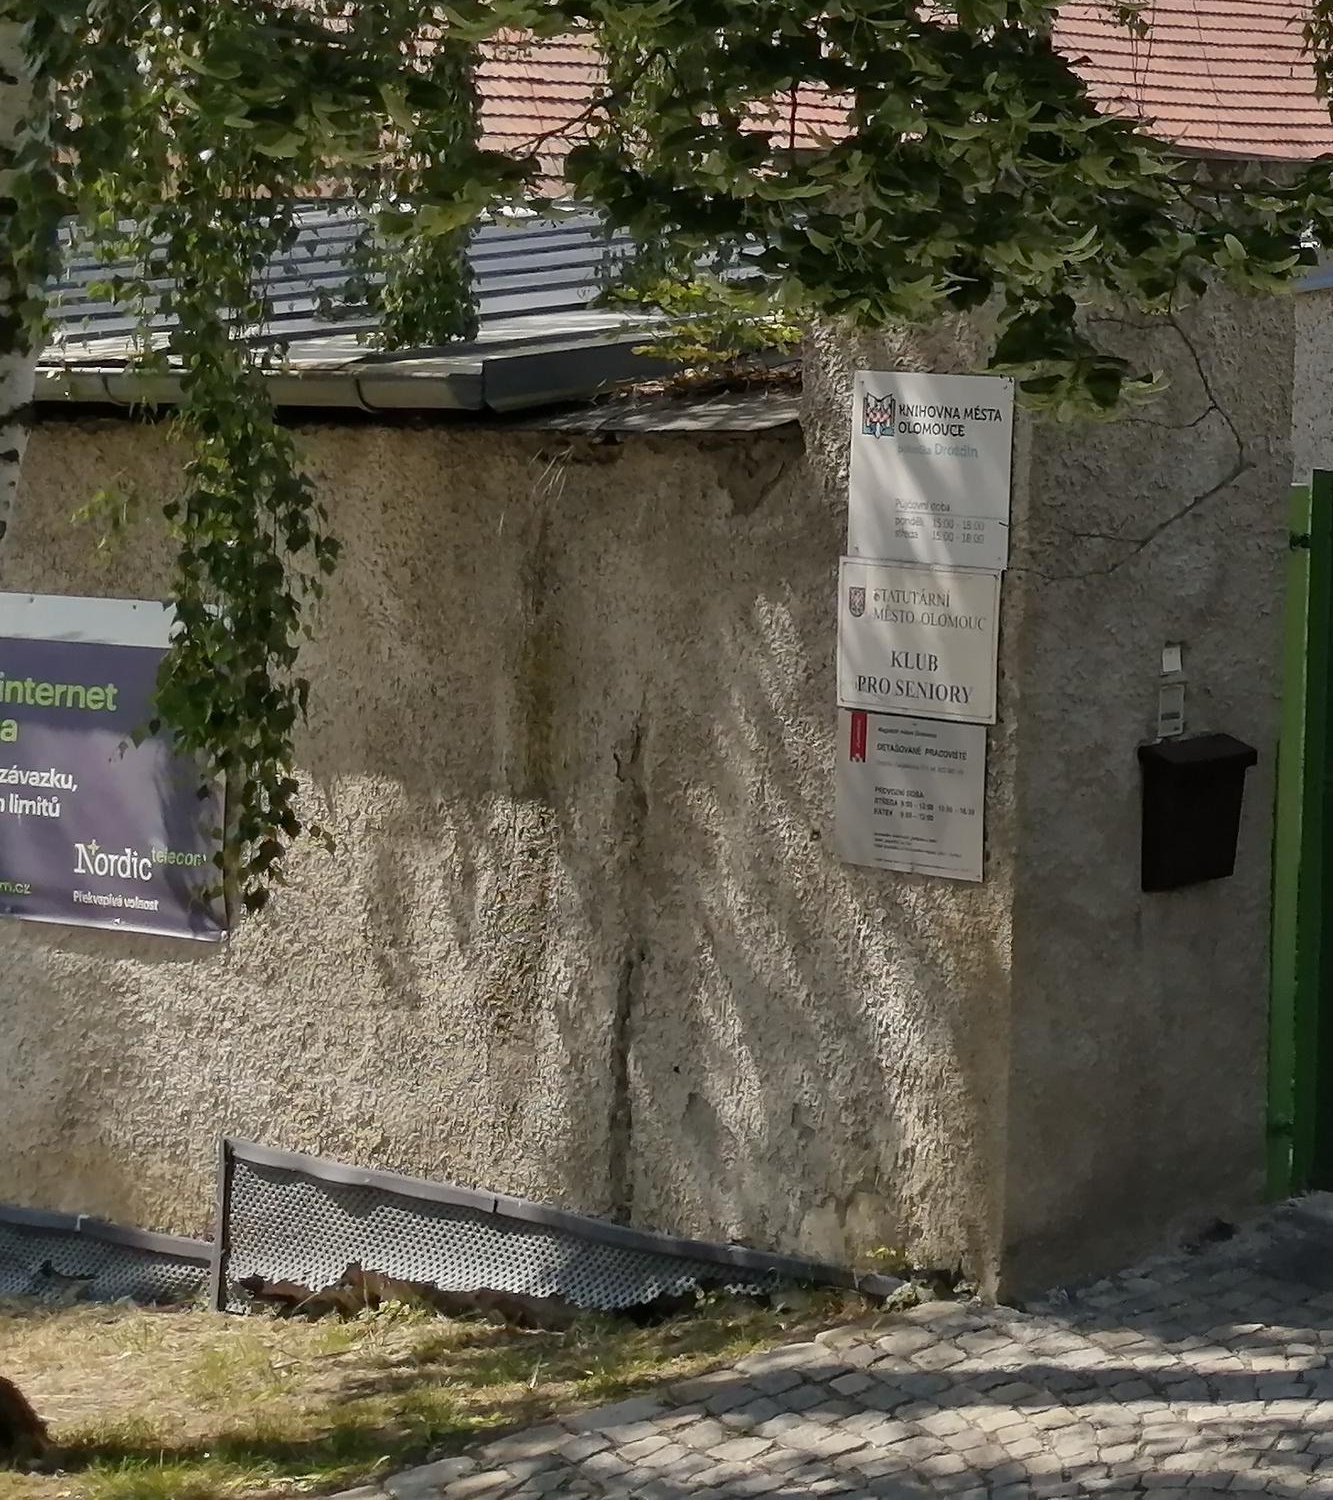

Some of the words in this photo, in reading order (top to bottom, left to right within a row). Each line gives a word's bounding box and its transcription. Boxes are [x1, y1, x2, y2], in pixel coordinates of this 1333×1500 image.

[898, 404, 961, 419] KNIHOVNA
[898, 421, 966, 437] OLOMOUCE
[873, 588, 950, 608] STATUTÁRNÍ
[921, 612, 987, 631] OLOMOUC
[891, 650, 938, 672] KLUB
[0, 671, 118, 711] internet
[856, 675, 891, 695] PRO
[895, 679, 972, 704] SENIORY
[0, 765, 78, 792] závazku,
[9, 793, 61, 817] limitů
[73, 841, 152, 881] Nordic
